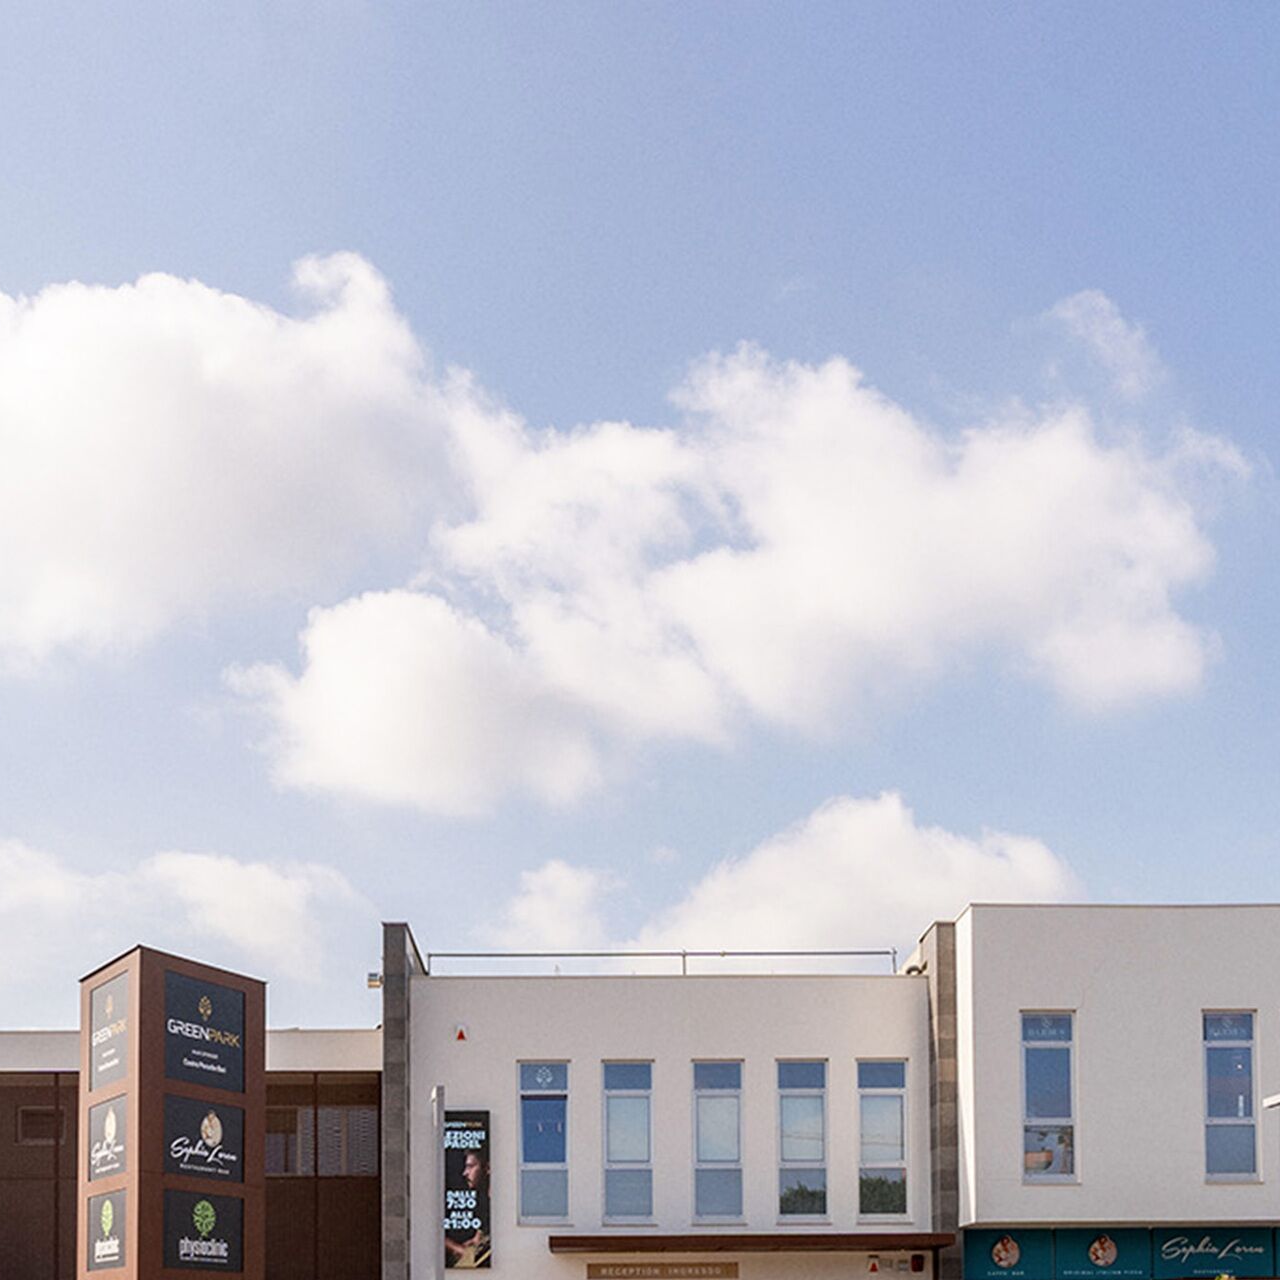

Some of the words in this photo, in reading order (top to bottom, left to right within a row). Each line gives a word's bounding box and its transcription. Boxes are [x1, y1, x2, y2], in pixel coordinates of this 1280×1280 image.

[167, 1019, 240, 1048] GREENPARK
[445, 1130, 486, 1140] EZIONI
[447, 1199, 477, 1209] 7:30
[442, 1218, 482, 1229] 21:00
[600, 1266, 660, 1276] RECEPTION
